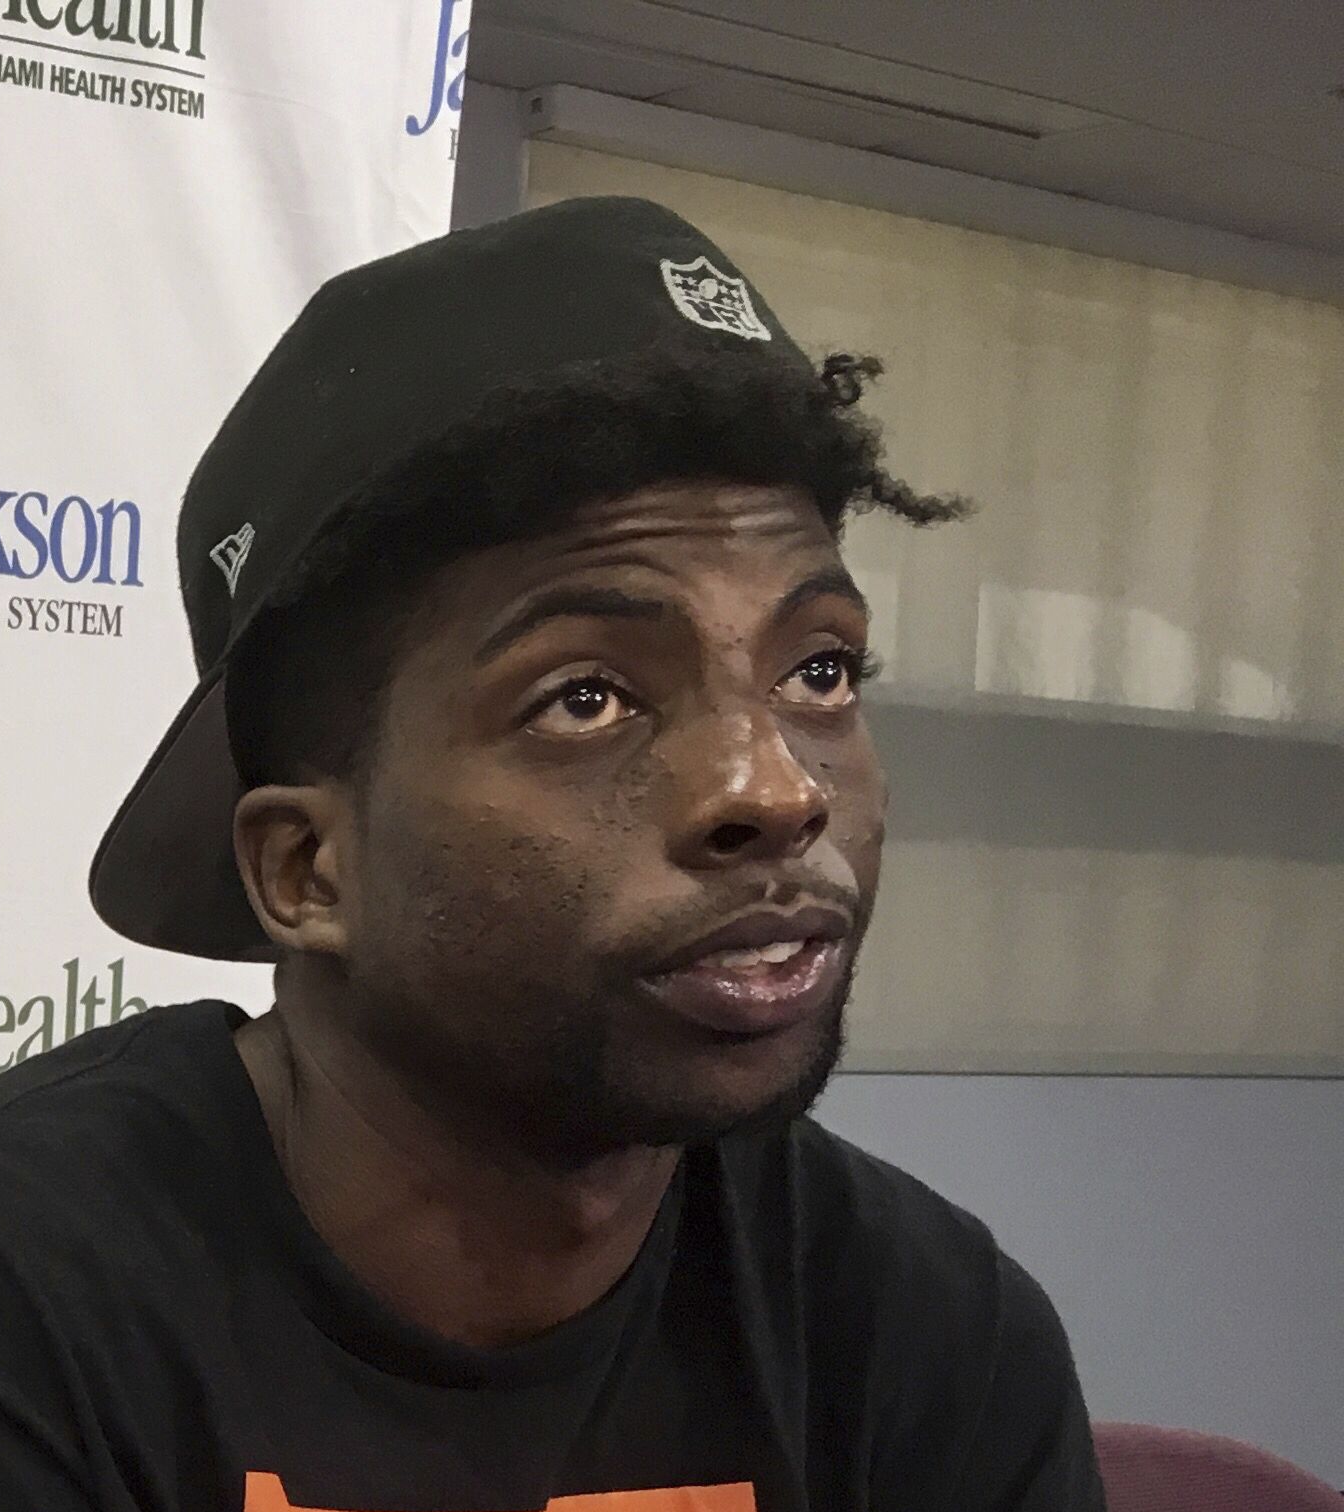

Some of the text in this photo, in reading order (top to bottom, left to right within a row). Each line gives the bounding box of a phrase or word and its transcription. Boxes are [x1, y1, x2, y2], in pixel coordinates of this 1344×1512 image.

[50, 64, 126, 105] HEALTH
[130, 79, 205, 119] SYSTEM
[6, 596, 124, 638] SYSTEM
